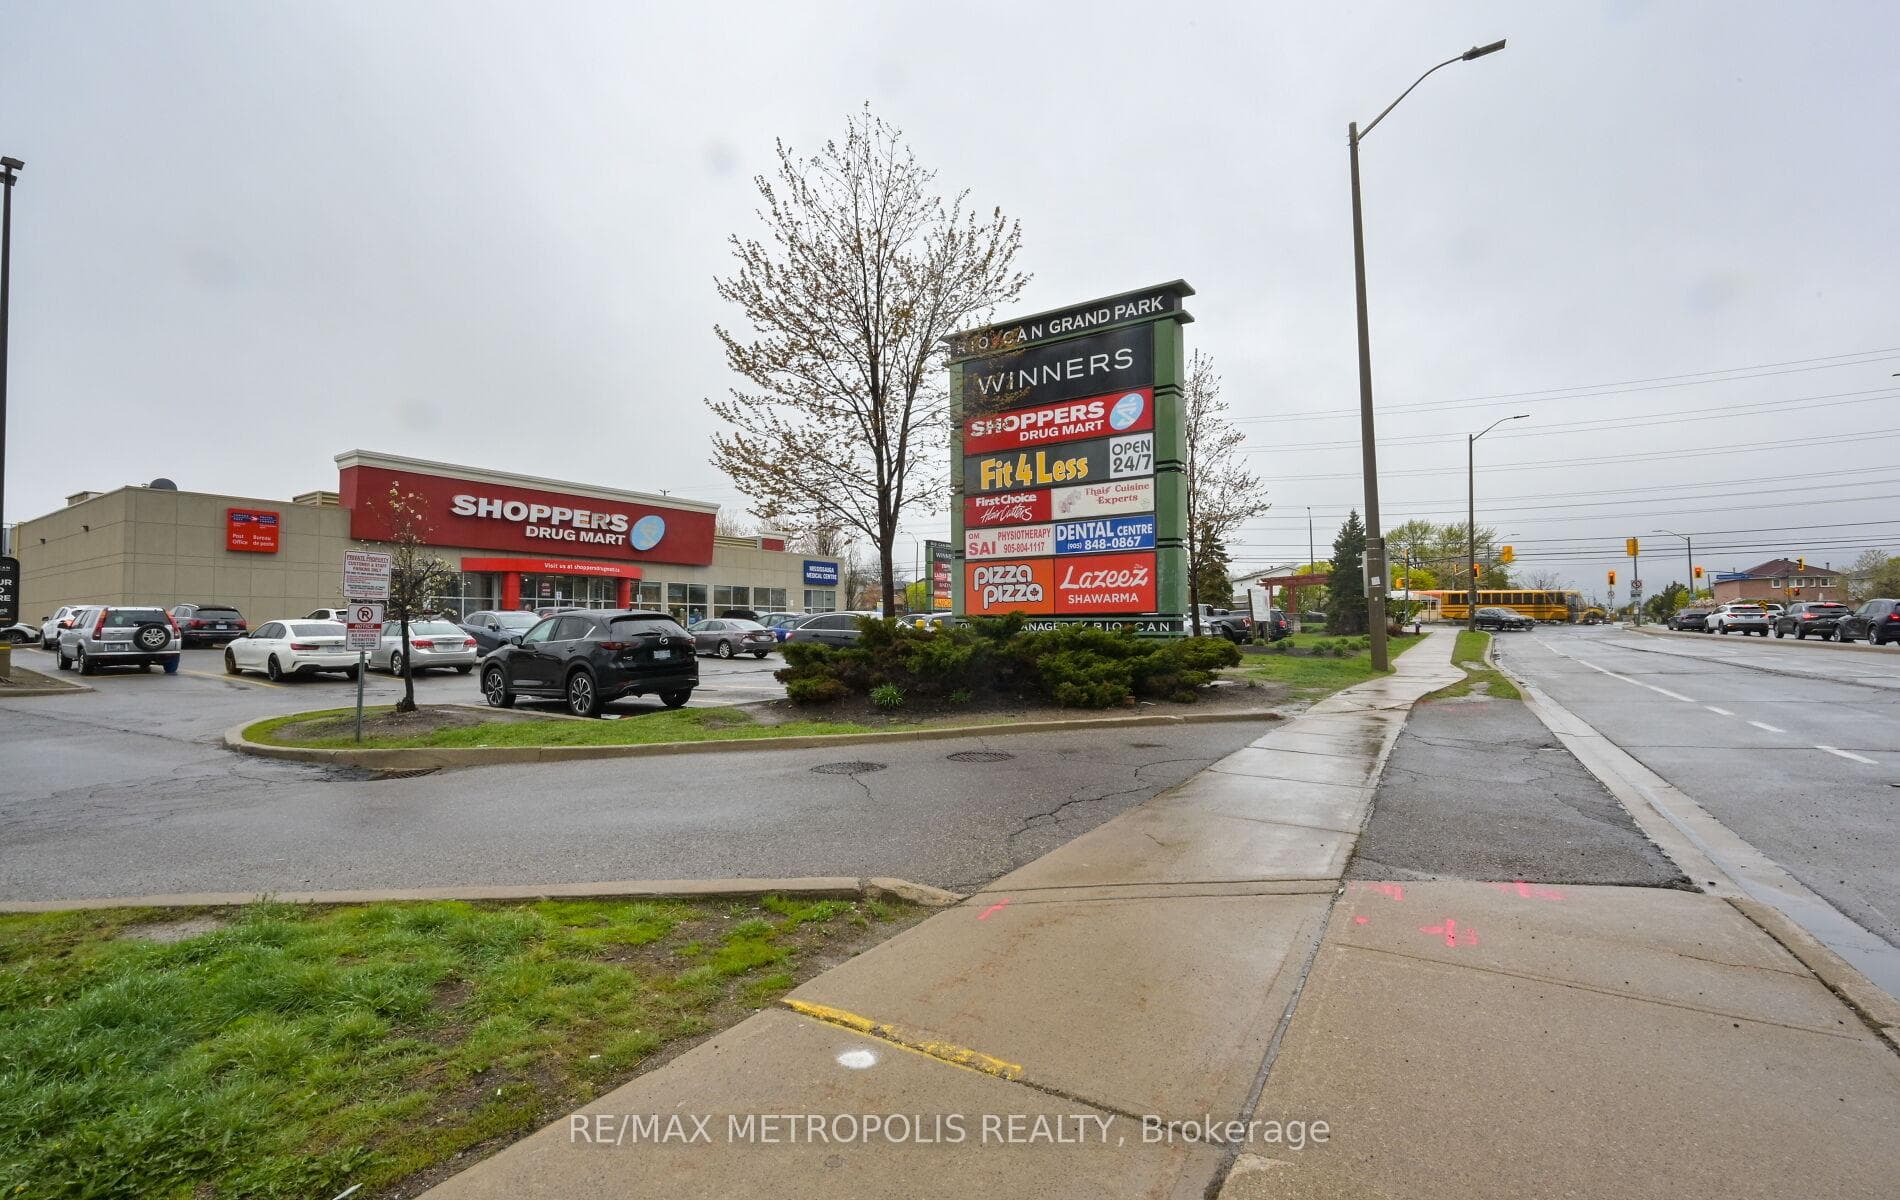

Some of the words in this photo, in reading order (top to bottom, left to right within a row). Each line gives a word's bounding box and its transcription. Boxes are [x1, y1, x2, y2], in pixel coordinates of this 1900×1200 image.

[1002, 323, 1043, 345] CAN
[1049, 308, 1111, 335] GRAND
[1114, 295, 1165, 321] PARK
[977, 348, 1134, 396] WINNERS
[970, 400, 1106, 437] SHOPPERS
[1019, 427, 1059, 442] DRUG
[1062, 418, 1105, 436] MART
[1111, 439, 1151, 456] OPEN
[980, 457, 1013, 490] Fit
[1015, 453, 1033, 487] 4
[1035, 451, 1089, 485] Less
[1112, 454, 1152, 474] 24/7
[1114, 482, 1150, 493] Cuisine
[975, 496, 1000, 507] First
[1000, 493, 1037, 505] Choice
[1097, 494, 1138, 505] Experts
[451, 494, 629, 532] SHOPPERS
[525, 525, 577, 541] DRUG
[579, 530, 626, 546] MART
[968, 532, 980, 540] OM
[997, 528, 1052, 541] PHYSIOTHERAPY
[1056, 520, 1115, 542] DENTAL
[1117, 523, 1153, 536] CENTRE
[968, 540, 997, 556] SAI
[1067, 542, 1082, 550] (905)
[1084, 535, 1142, 551] 848-0867
[973, 564, 1033, 591] pizza
[1059, 563, 1149, 590] Lazeez
[983, 583, 1043, 610] pizza
[1068, 592, 1139, 604] SHAWARMA
[1134, 622, 1170, 632] CAN
